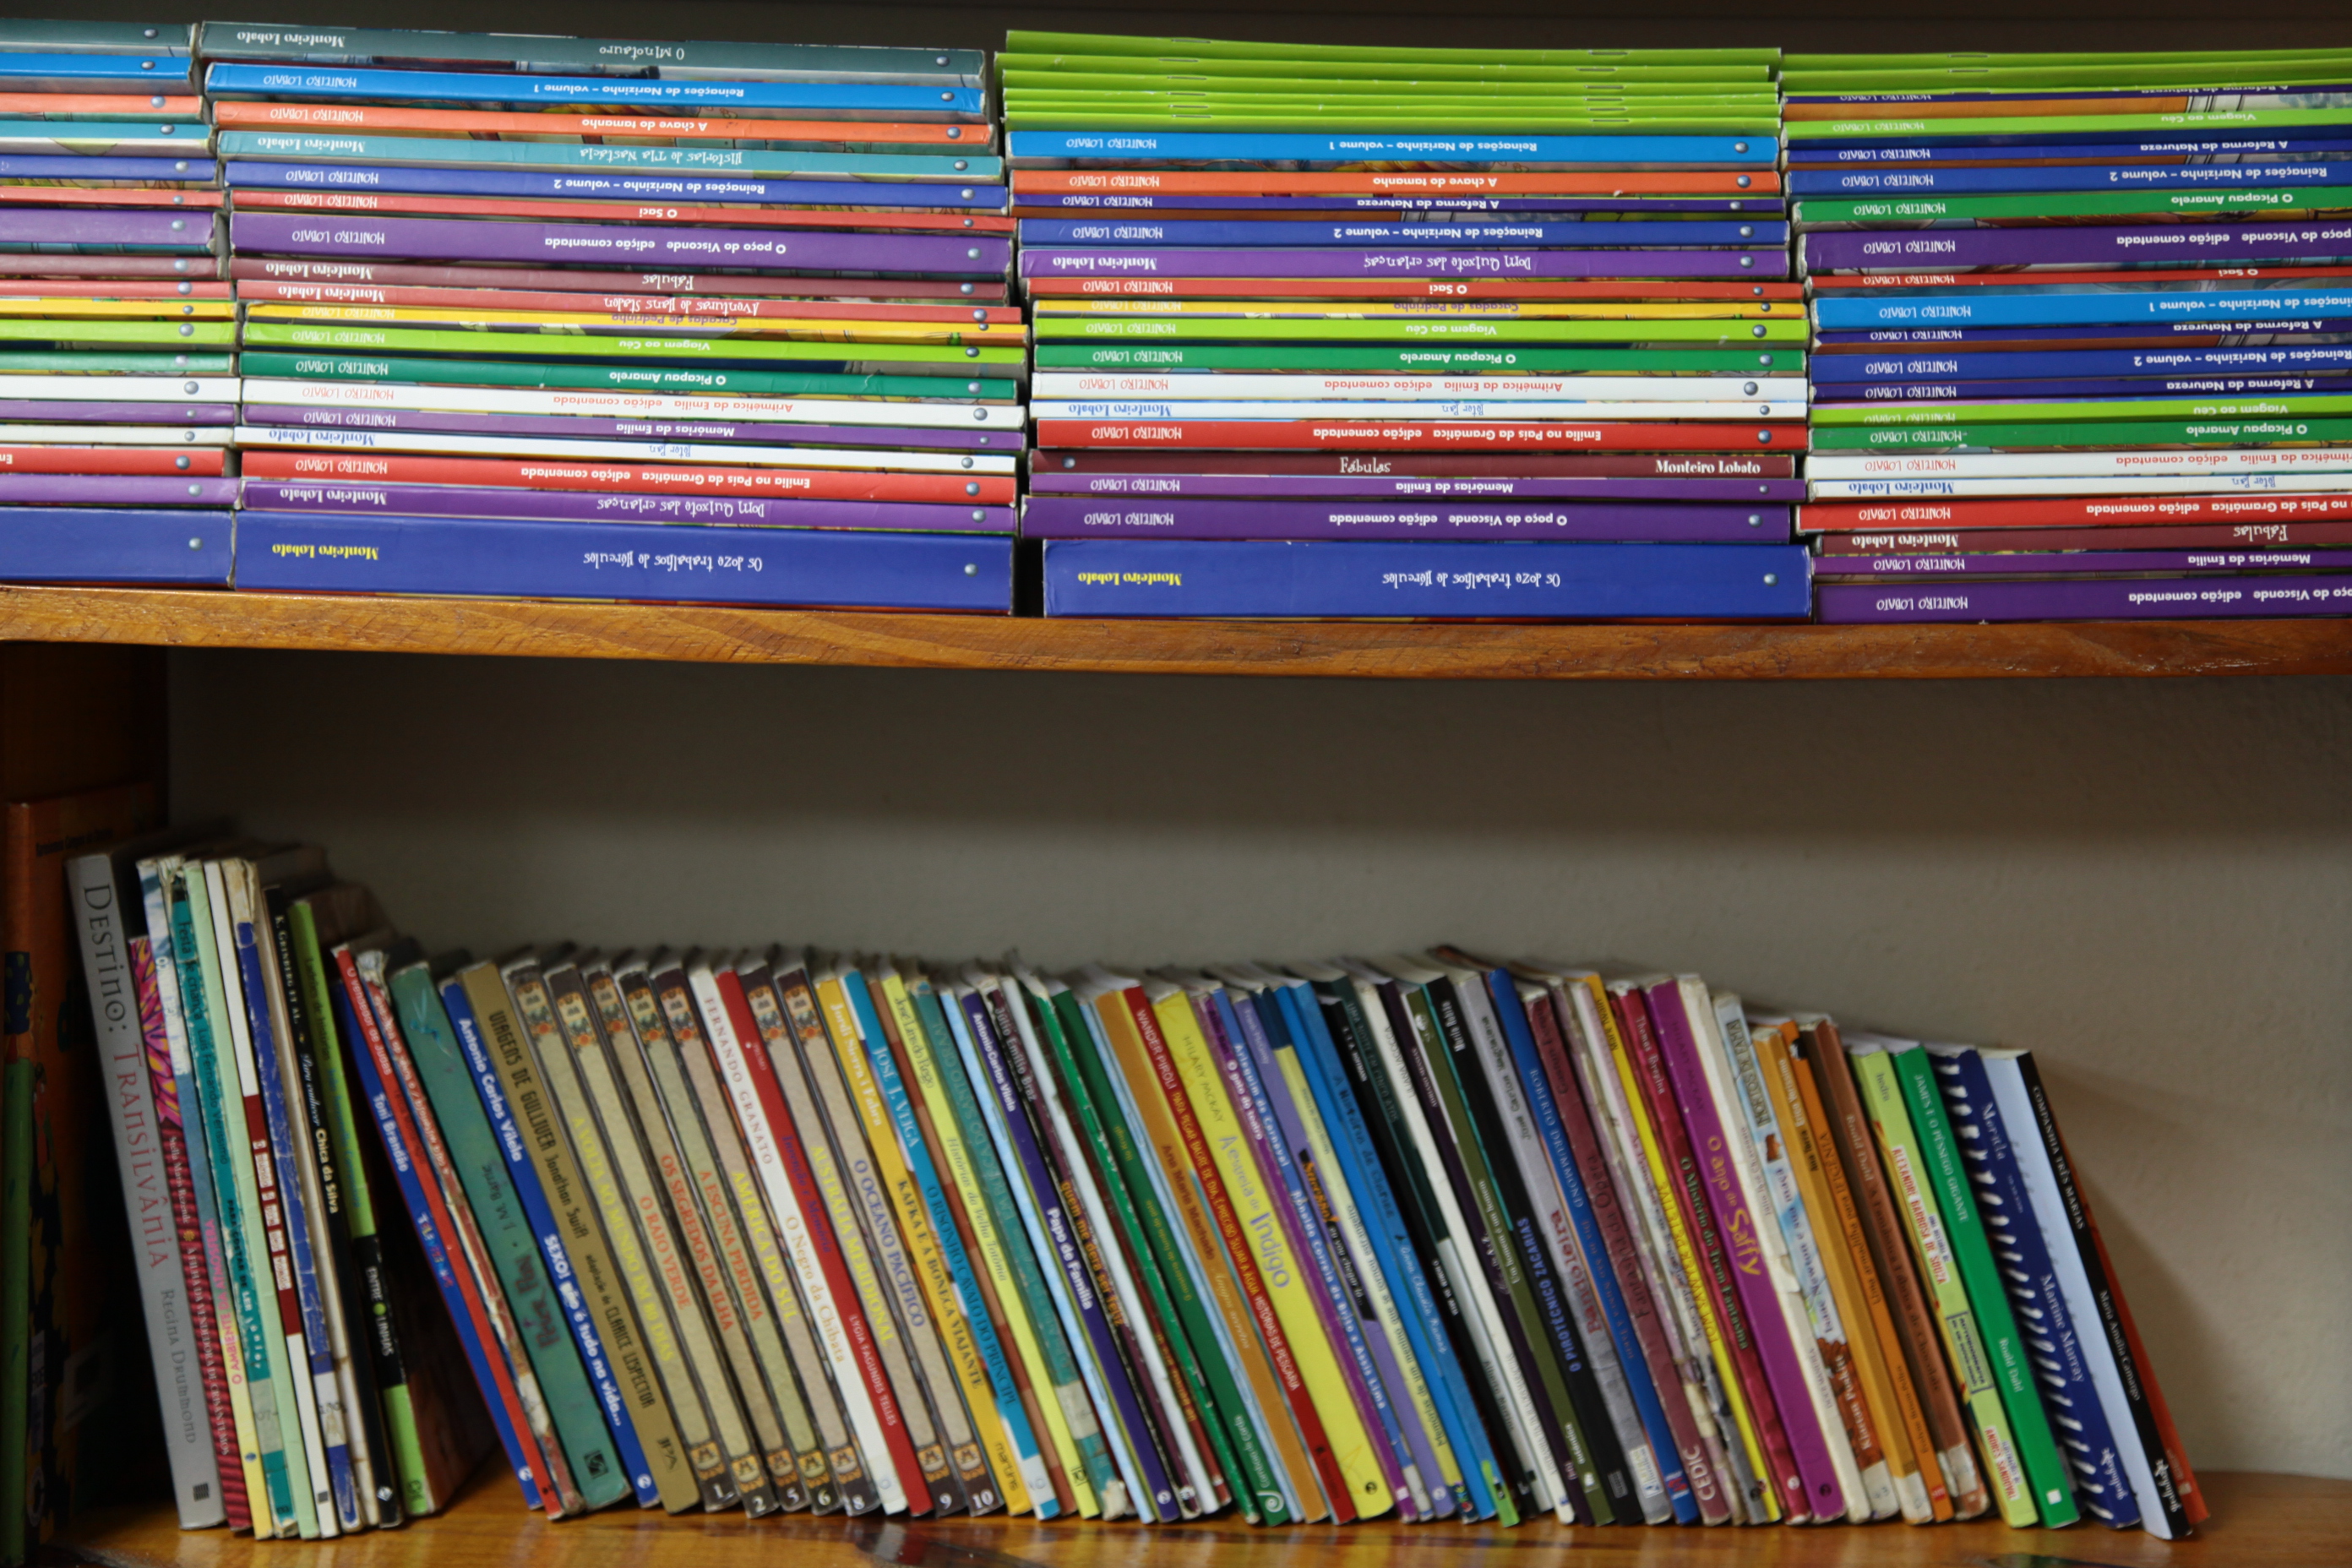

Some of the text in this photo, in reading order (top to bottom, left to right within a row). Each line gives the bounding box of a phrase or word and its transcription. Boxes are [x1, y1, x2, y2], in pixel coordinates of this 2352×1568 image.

[237, 31, 345, 46] Monteiro Lobato
[675, 46, 685, 60] O
[258, 137, 365, 152] Monteiro Lobato
[2110, 166, 2327, 182] Reinações de Narizinho volume 2
[1070, 175, 1160, 187] MONTEIRO LOBATO
[1373, 176, 1497, 187] A chave do tamanho
[609, 371, 726, 384] O Picapau Amarelo
[1324, 378, 1562, 392] Aritmética da Emília edição comentada
[280, 488, 387, 505] Monteiro Lobato
[1656, 460, 1761, 476] Monteiro Lobato
[660, 499, 681, 514] das
[1859, 506, 1951, 521] MONTEIRO LOBATO
[2086, 500, 2348, 516] no País da Gramática edição comentada
[1852, 534, 1959, 550] Monteiro Lobato
[1874, 558, 1965, 572] MONTEIRO LOBATO
[2188, 553, 2310, 566] Memórias da Emília
[1078, 571, 1182, 585] Monteiro Lobato
[1436, 572, 1449, 587] de
[457, 1016, 523, 1162] Antonio Carlos Vilela
[487, 1009, 557, 1152] VIAGENS DE GULLIVER
[702, 997, 774, 1165] FERNANDO GRANATO
[873, 1046, 922, 1147] JOSÉ J. VEIGA
[1225, 1059, 1264, 1141] O gato do teatro
[1724, 1021, 1771, 1124] MORTOS DE FAMA
[372, 1092, 410, 1173] Toni Brandão
[1526, 1068, 1587, 1209] ROBERTO DRUMMOND
[2028, 1085, 2087, 1230] COMPANHIA TRÊS MARIAS
[313, 1128, 340, 1214] Chica da Silva
[543, 1152, 588, 1239] Jonathan Swift
[1217, 1133, 1239, 1150] A
[1248, 1197, 1260, 1212] de
[1704, 1134, 1767, 1280] O anjo de Saffy
[543, 1233, 569, 1280] SEXO!
[638, 1195, 692, 1309] O RAIO VERDE
[728, 1167, 799, 1324] AMÉRICA DO SUL
[852, 1157, 929, 1328] O OCEANO PACÍFICO
[1044, 1207, 1096, 1309] Papo de Família
[1543, 1209, 1604, 1335] Bandoleira
[1678, 1156, 1752, 1350] O Mistério do Trem Fantasma
[202, 1218, 242, 1385] O AMBIENTE DA ATMOSFERA
[365, 1266, 393, 1356] ENTRE LINHAS
[573, 1309, 589, 1323] é
[784, 1215, 850, 1363] O Negro da Chibata
[896, 1179, 984, 1389] KAFKA E A BONECA VIAJANTE
[1515, 1217, 1582, 1373] O PIROTÉCNICO ZACARIAS
[577, 1321, 599, 1358] tudo
[604, 1304, 656, 1410] CLARICE LISPECTOR
[2037, 1272, 2088, 1384] Martine Murray
[2097, 1290, 2143, 1402] Maria Amália Camargo
[591, 1358, 606, 1380] na
[1996, 1337, 2024, 1392] Roald Dahl
[970, 1487, 995, 1510] 10
[994, 1440, 1021, 1491] martins
[1680, 1444, 1718, 1502] CEDIC
[751, 1494, 767, 1513] 2
